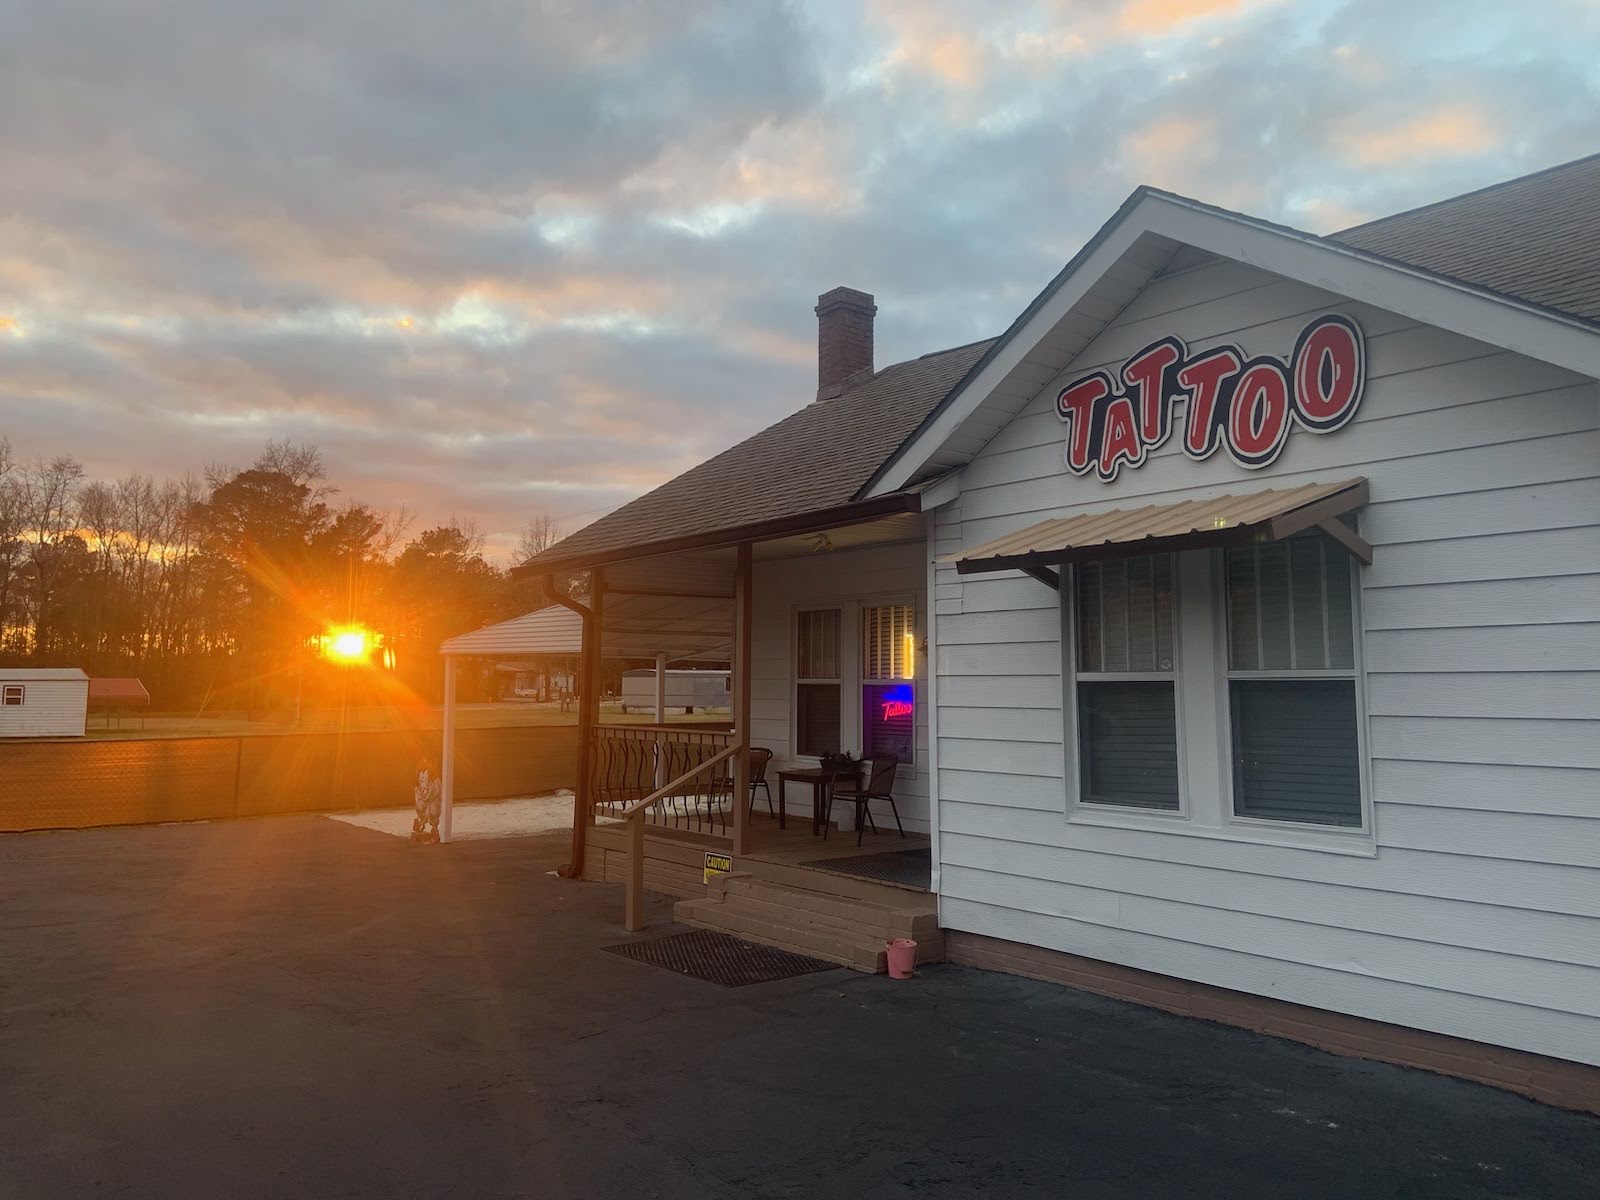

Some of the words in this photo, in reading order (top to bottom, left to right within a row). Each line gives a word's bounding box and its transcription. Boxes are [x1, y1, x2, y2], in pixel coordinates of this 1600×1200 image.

[1057, 315, 1363, 480] TATTOO
[881, 701, 913, 721] Tattoo
[706, 855, 730, 871] CAUTION
